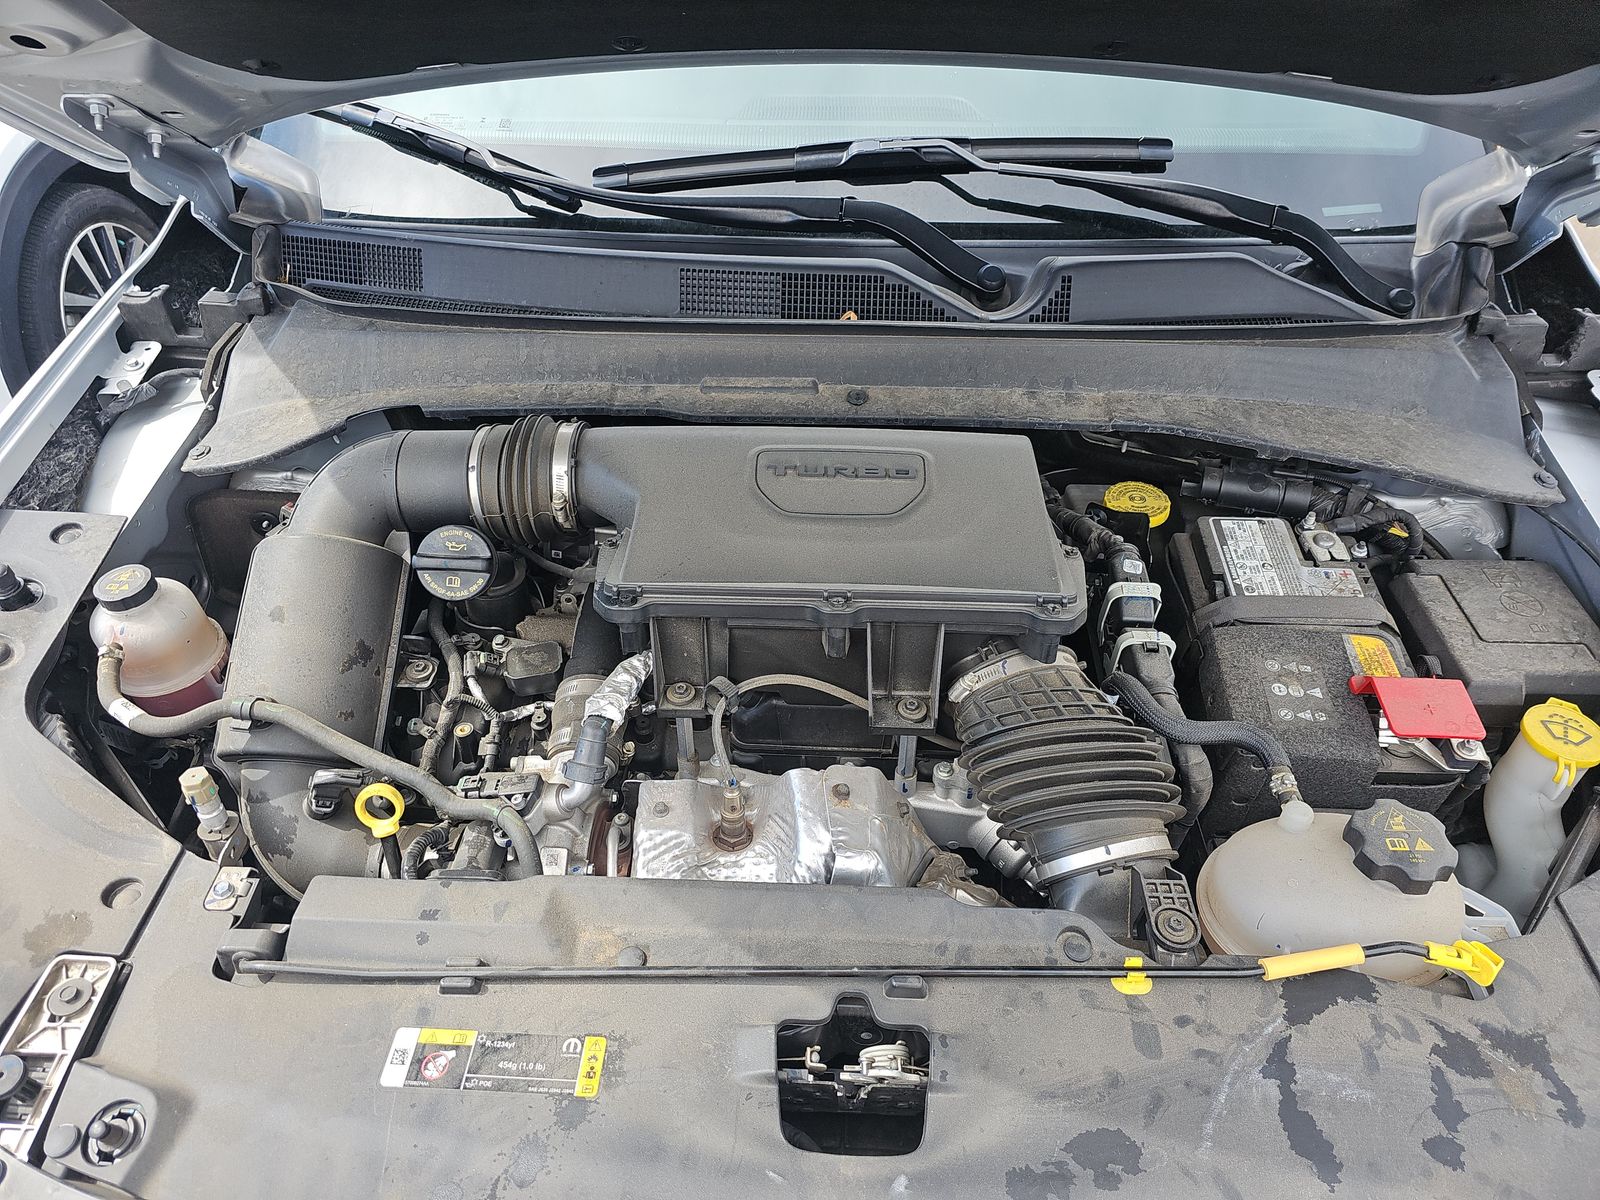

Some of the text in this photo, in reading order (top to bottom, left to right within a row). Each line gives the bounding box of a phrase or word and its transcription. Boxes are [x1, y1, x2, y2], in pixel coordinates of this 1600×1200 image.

[766, 464, 918, 480] TURBO
[440, 529, 474, 541] ENGINE OIL
[423, 573, 431, 584] API
[469, 578, 484, 593] 5W-30
[485, 1040, 516, 1049] R-1234yf
[497, 1061, 546, 1071] 454g (1.0 lb)
